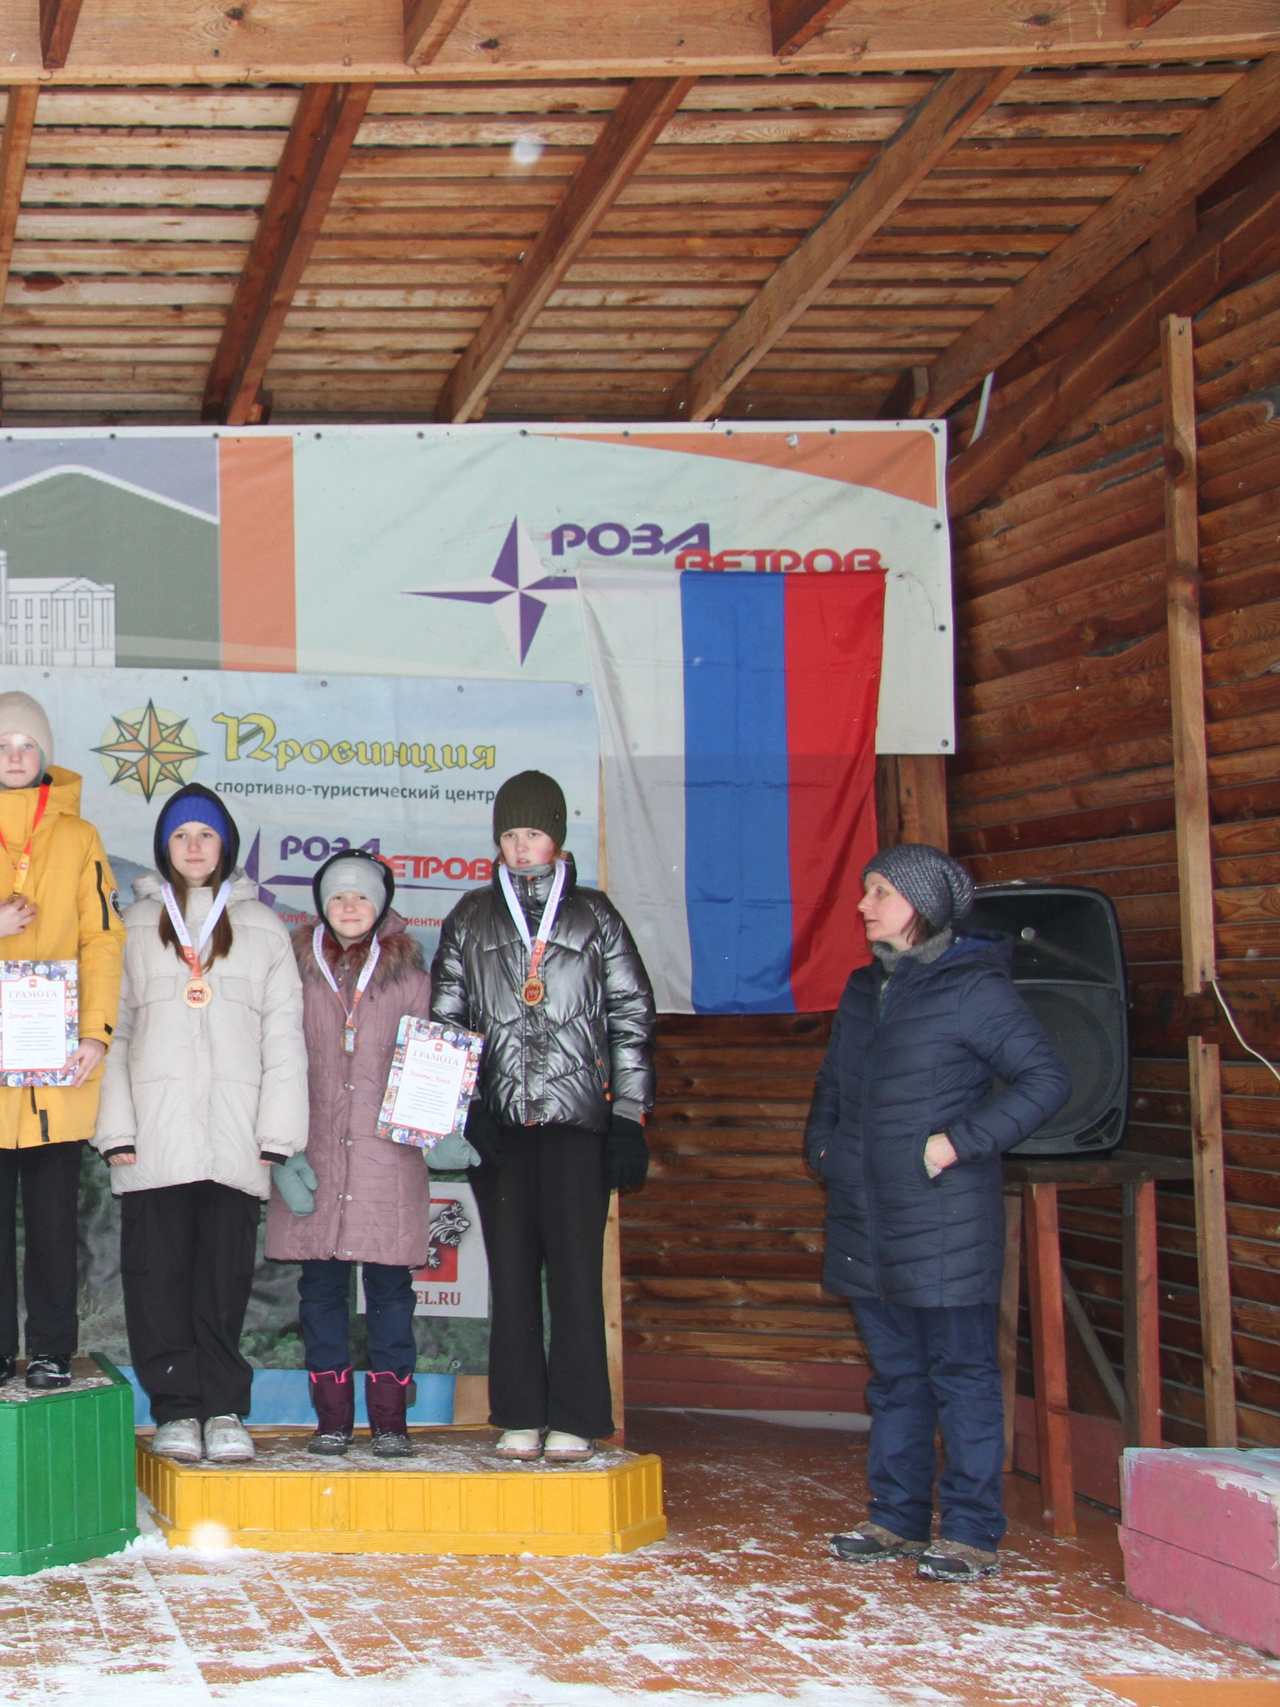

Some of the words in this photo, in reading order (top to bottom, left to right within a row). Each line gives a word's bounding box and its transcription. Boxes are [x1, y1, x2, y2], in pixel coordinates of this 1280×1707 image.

[550, 522, 710, 556] РОЗА
[212, 712, 496, 772] Провинция
[214, 782, 440, 800] спортивно-туристический
[445, 788, 496, 805] центр
[374, 853, 492, 881] ЕТРОВ
[8, 990, 58, 999] ГРАМОТА
[413, 1049, 459, 1067] ГРАМОТА
[414, 1291, 461, 1306] EL.RU
